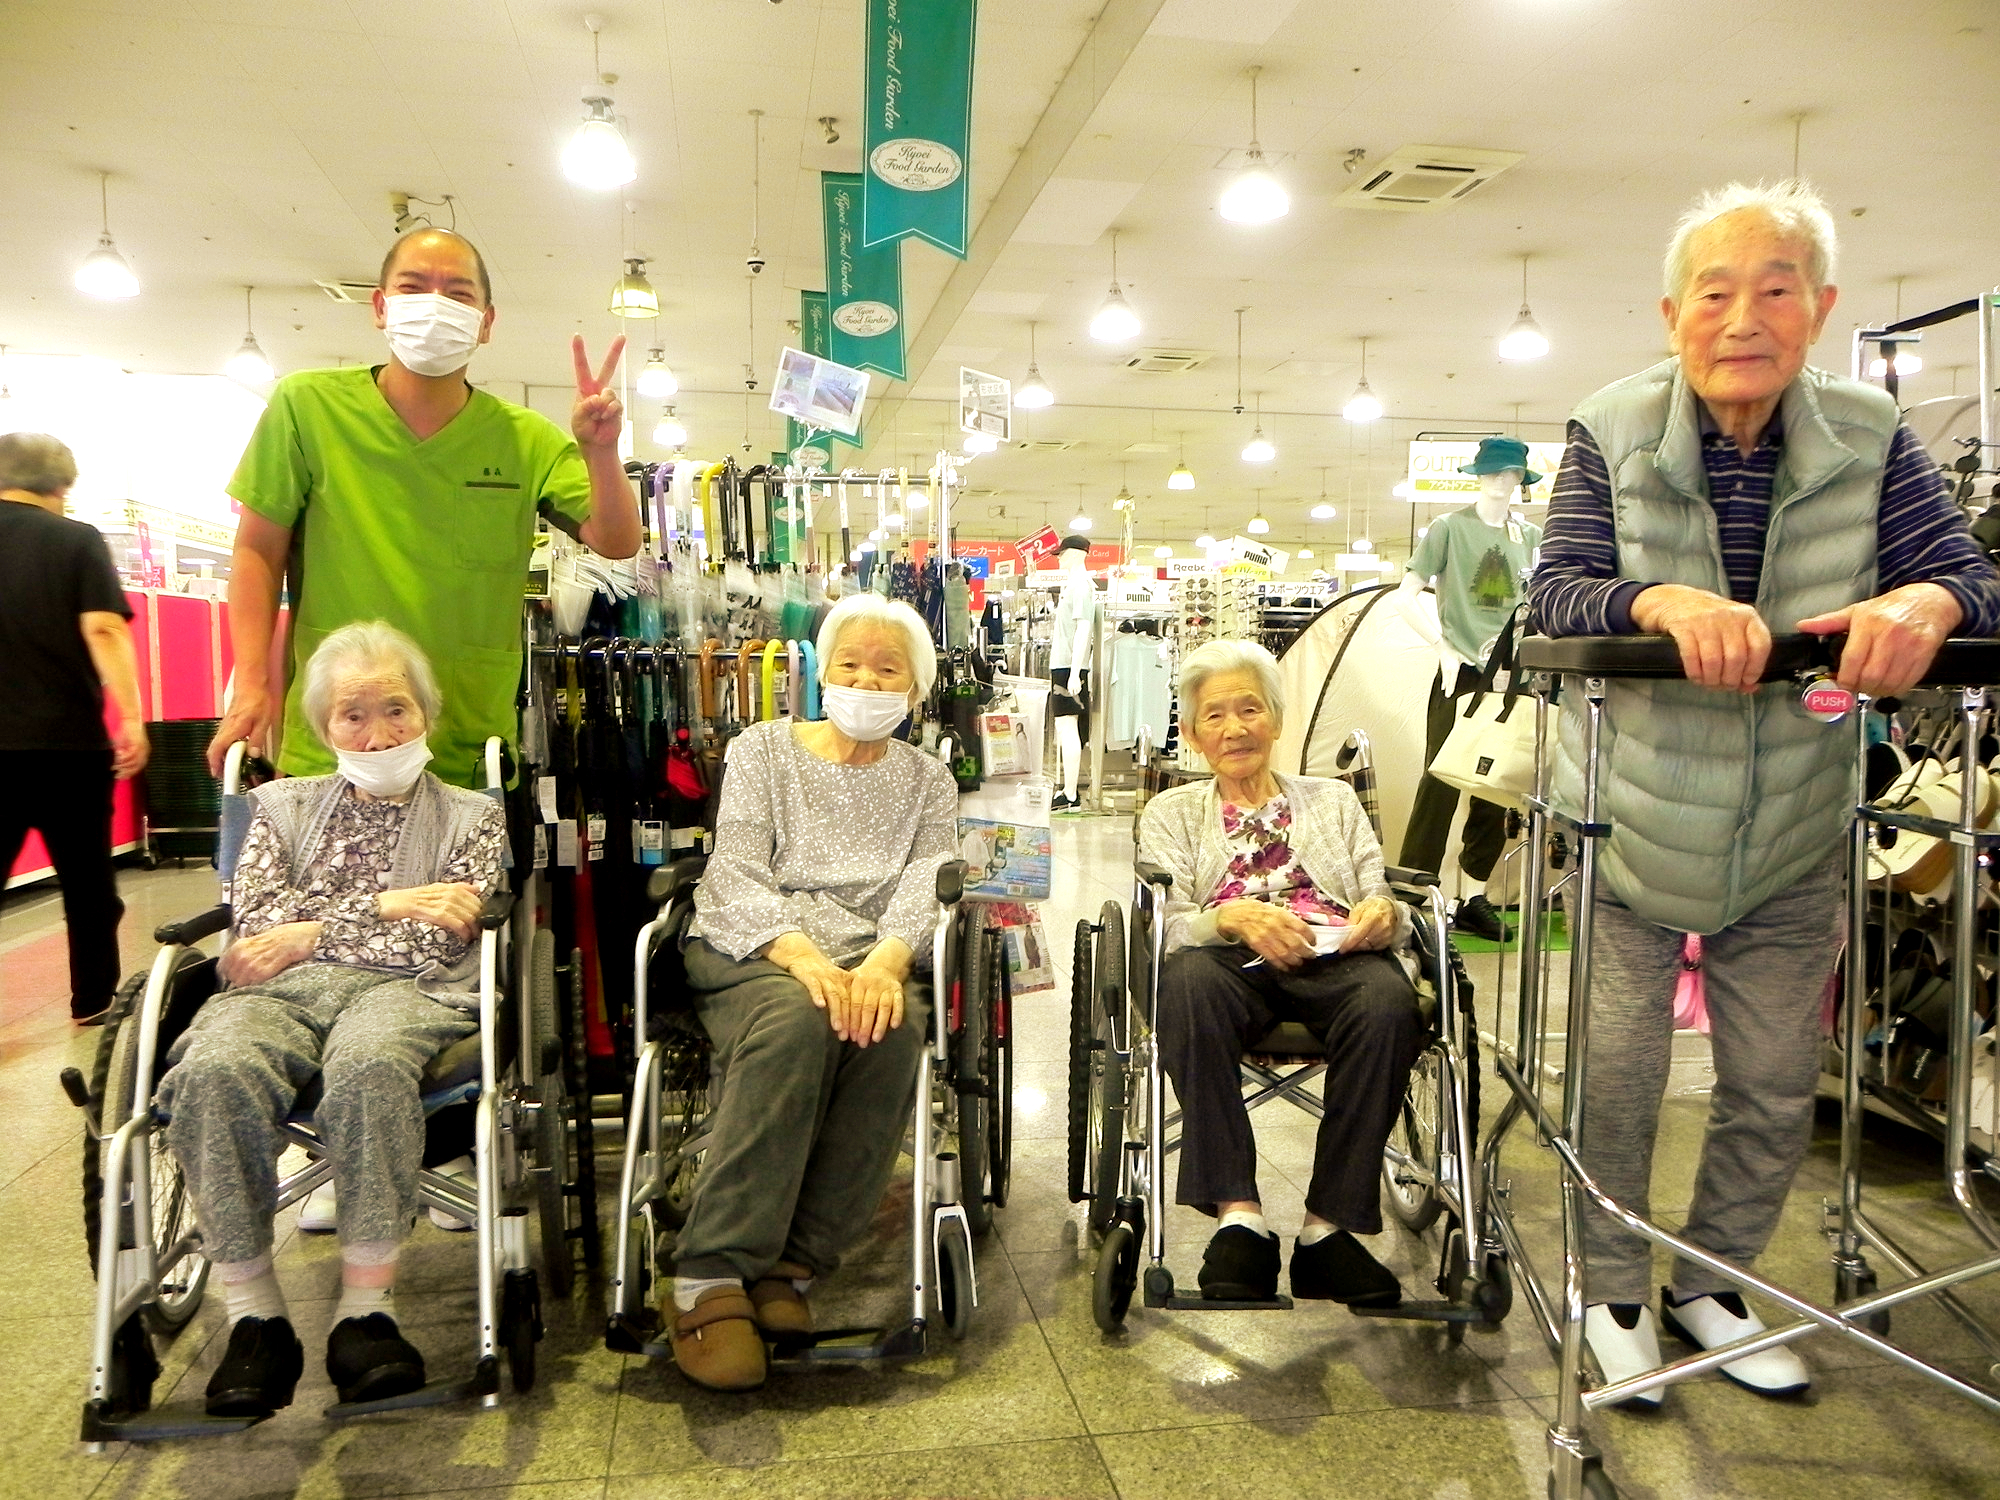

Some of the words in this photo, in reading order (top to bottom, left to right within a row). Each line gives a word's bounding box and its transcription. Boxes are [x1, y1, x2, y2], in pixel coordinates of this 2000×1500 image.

[887, 26, 903, 74] Food
[884, 75, 902, 130] Garden
[898, 146, 932, 161] Kyoei
[883, 158, 913, 171] Food
[913, 161, 949, 174] Garden
[834, 189, 850, 226] Kyoei
[839, 227, 851, 259] Food
[840, 260, 852, 297] Garden
[842, 315, 864, 324] Food
[864, 314, 889, 324] Garden
[852, 306, 875, 317] Kyoei
[1092, 550, 1110, 558] Card
[1244, 550, 1268, 566] PUMA
[1269, 584, 1325, 595] スポーツウエア
[1126, 593, 1151, 602] PUMA
[1811, 695, 1848, 707] PUSH
